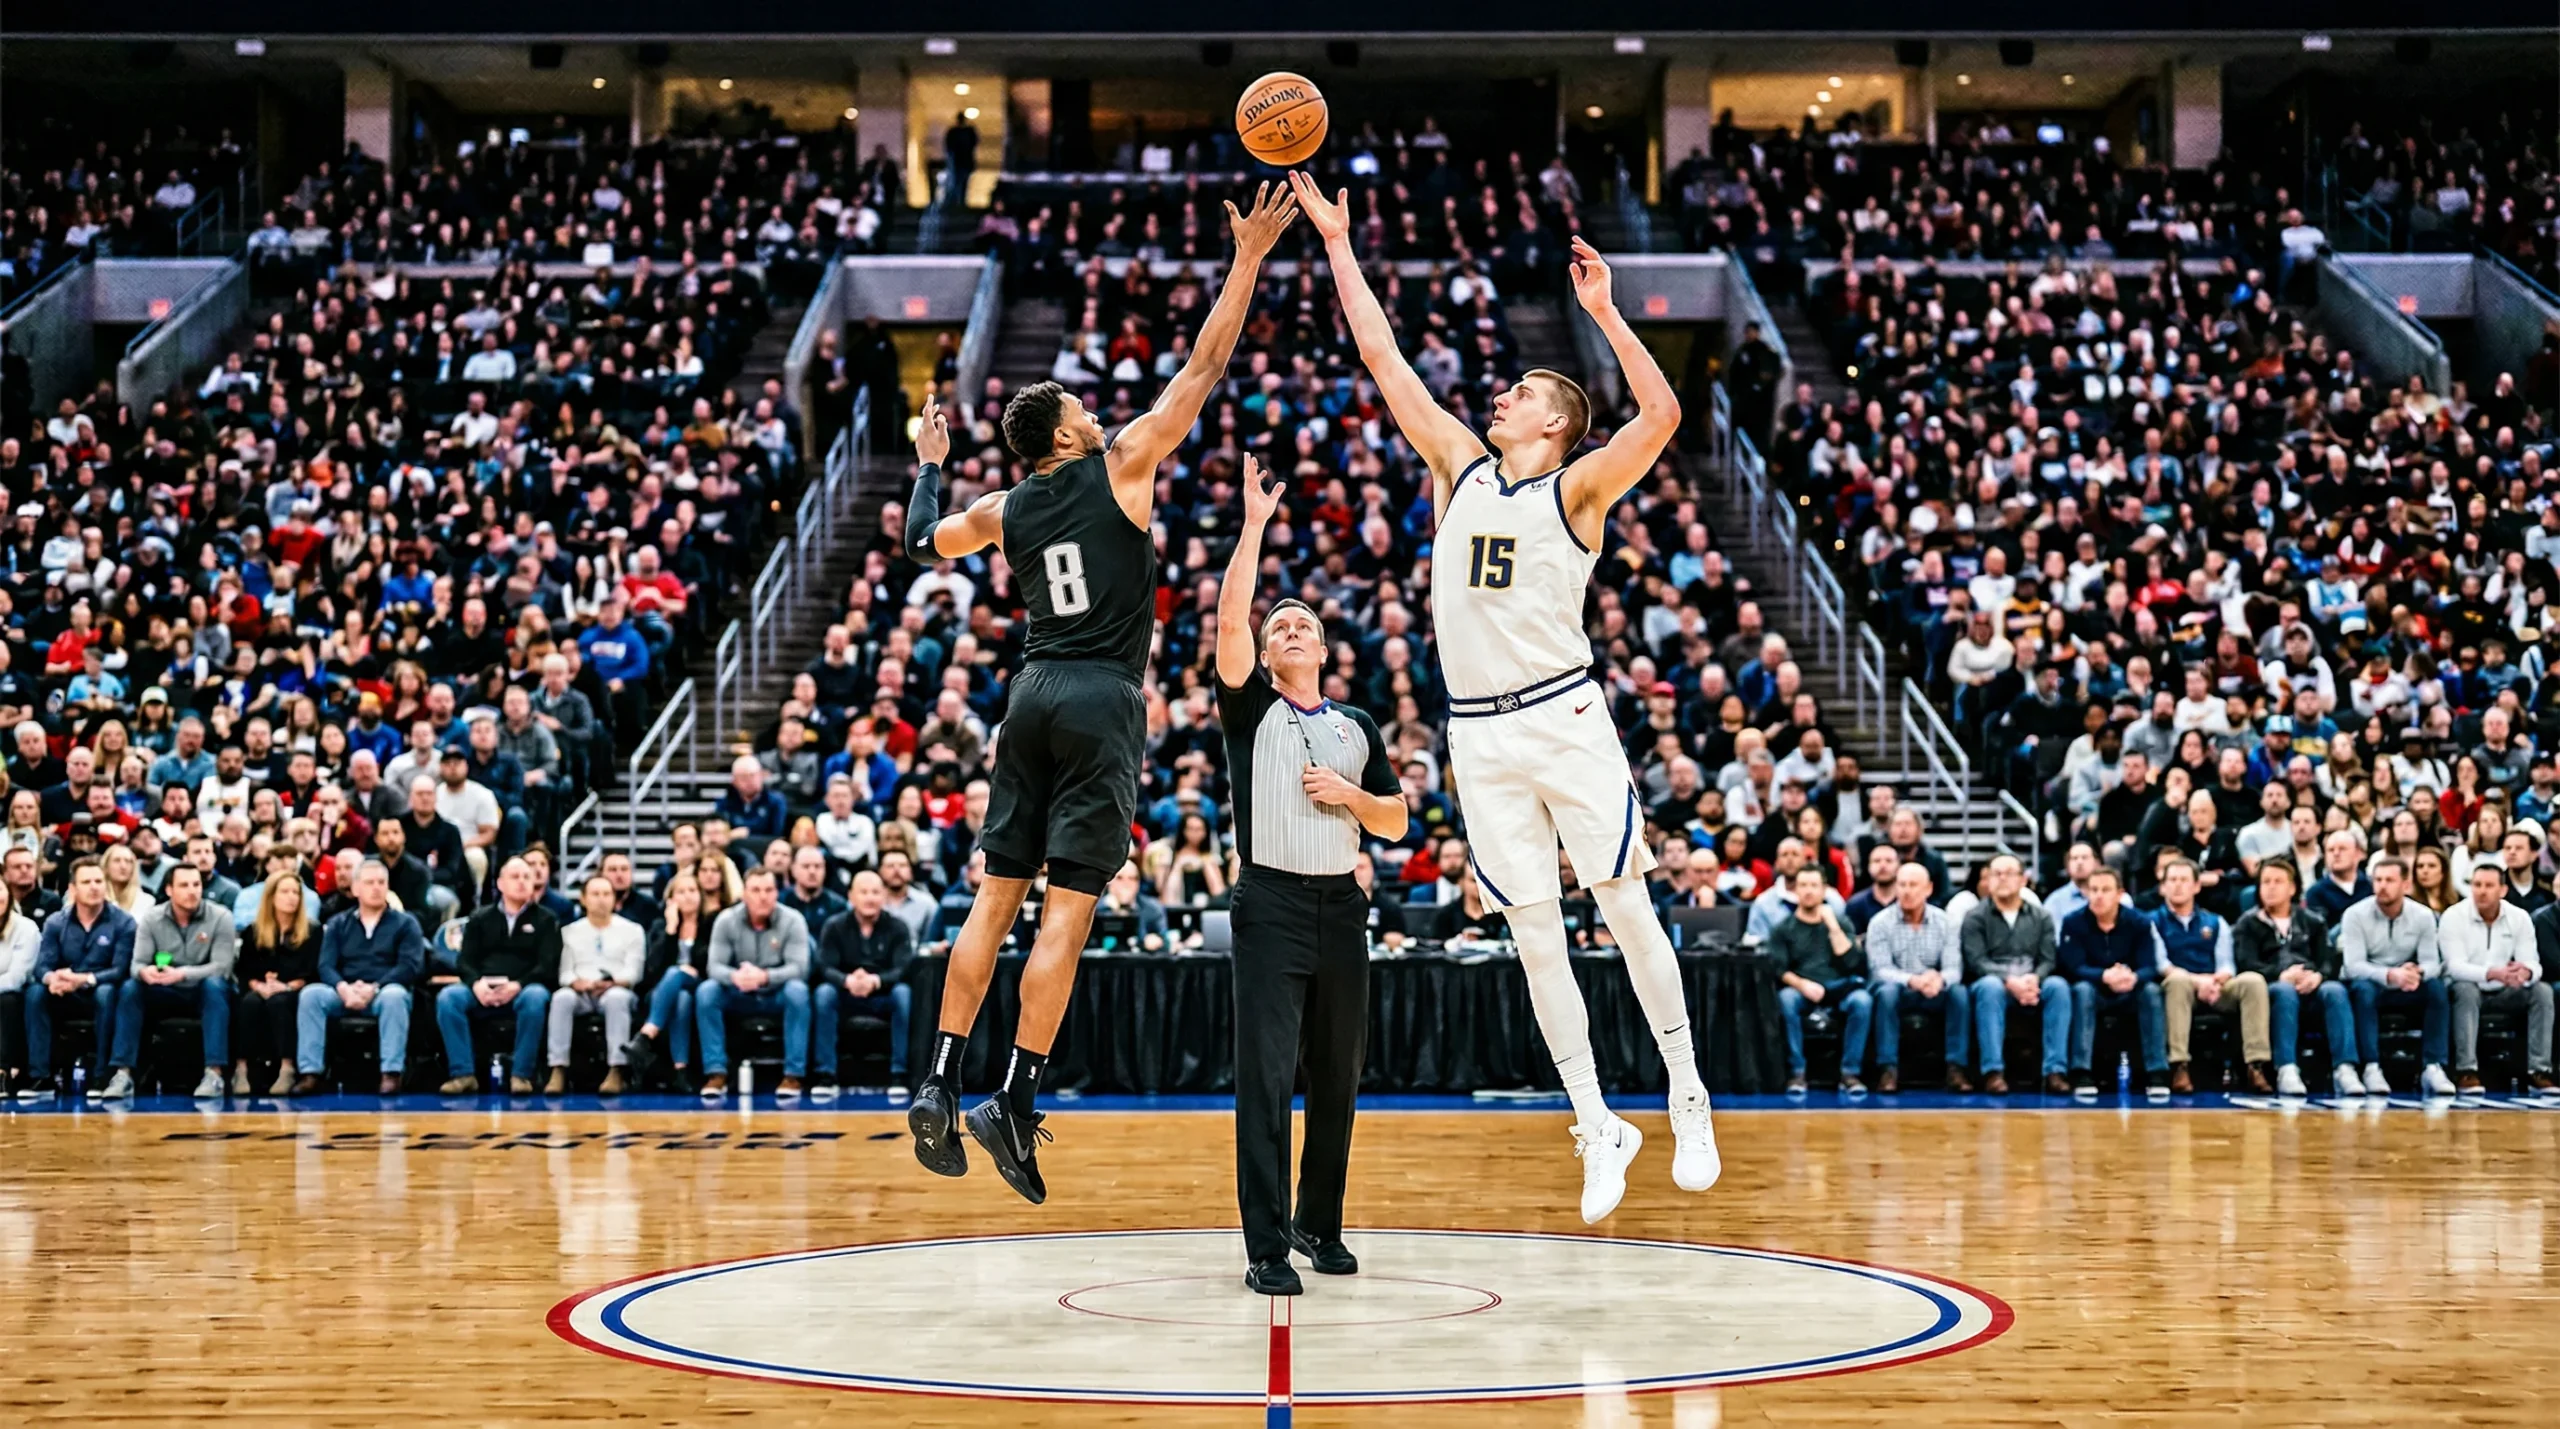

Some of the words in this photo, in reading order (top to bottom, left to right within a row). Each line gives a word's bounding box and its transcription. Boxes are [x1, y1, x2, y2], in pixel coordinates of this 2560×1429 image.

[1245, 87, 1304, 124] SPALDING
[1044, 541, 1090, 617] 8
[1468, 533, 1518, 592] 15
